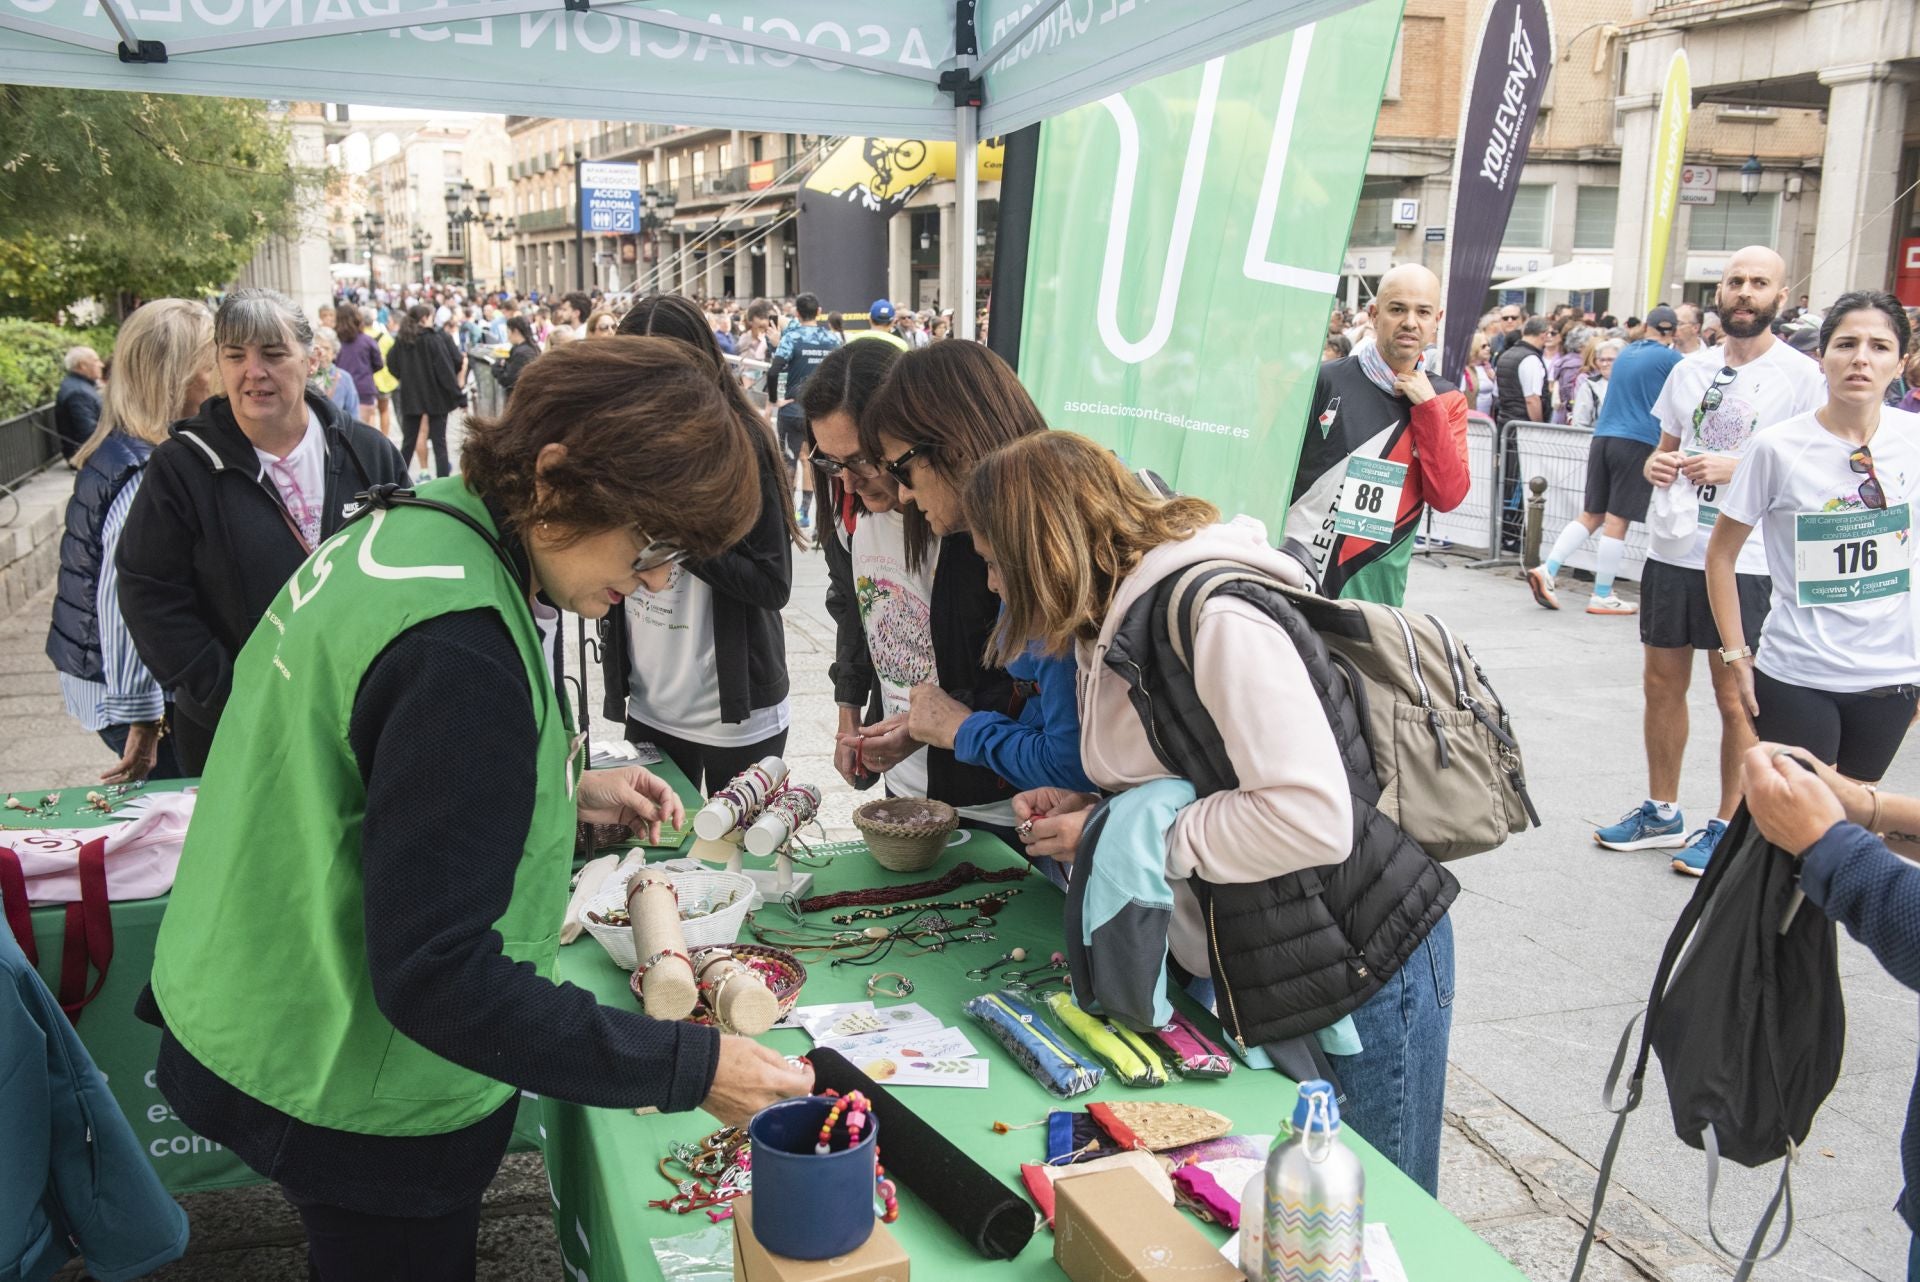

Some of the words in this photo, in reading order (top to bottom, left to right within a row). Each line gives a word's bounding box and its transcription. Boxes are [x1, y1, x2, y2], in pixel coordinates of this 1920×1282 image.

[1497, 150, 1513, 192] SPORTS
[1510, 103, 1528, 150] SERVICES
[593, 188, 632, 200] ACCESO
[589, 199, 636, 211] PEATONAL
[1354, 483, 1385, 514] 88
[343, 503, 360, 513] NIKE
[1817, 515, 1850, 525] Carrera
[1849, 511, 1880, 524] popular
[1880, 509, 1890, 517] 10
[1836, 519, 1875, 533] cajarural
[1822, 532, 1848, 540] CONTRA
[1833, 539, 1878, 574] 176
[1811, 586, 1848, 597] cajaviva
[1862, 576, 1899, 590] cajarural
